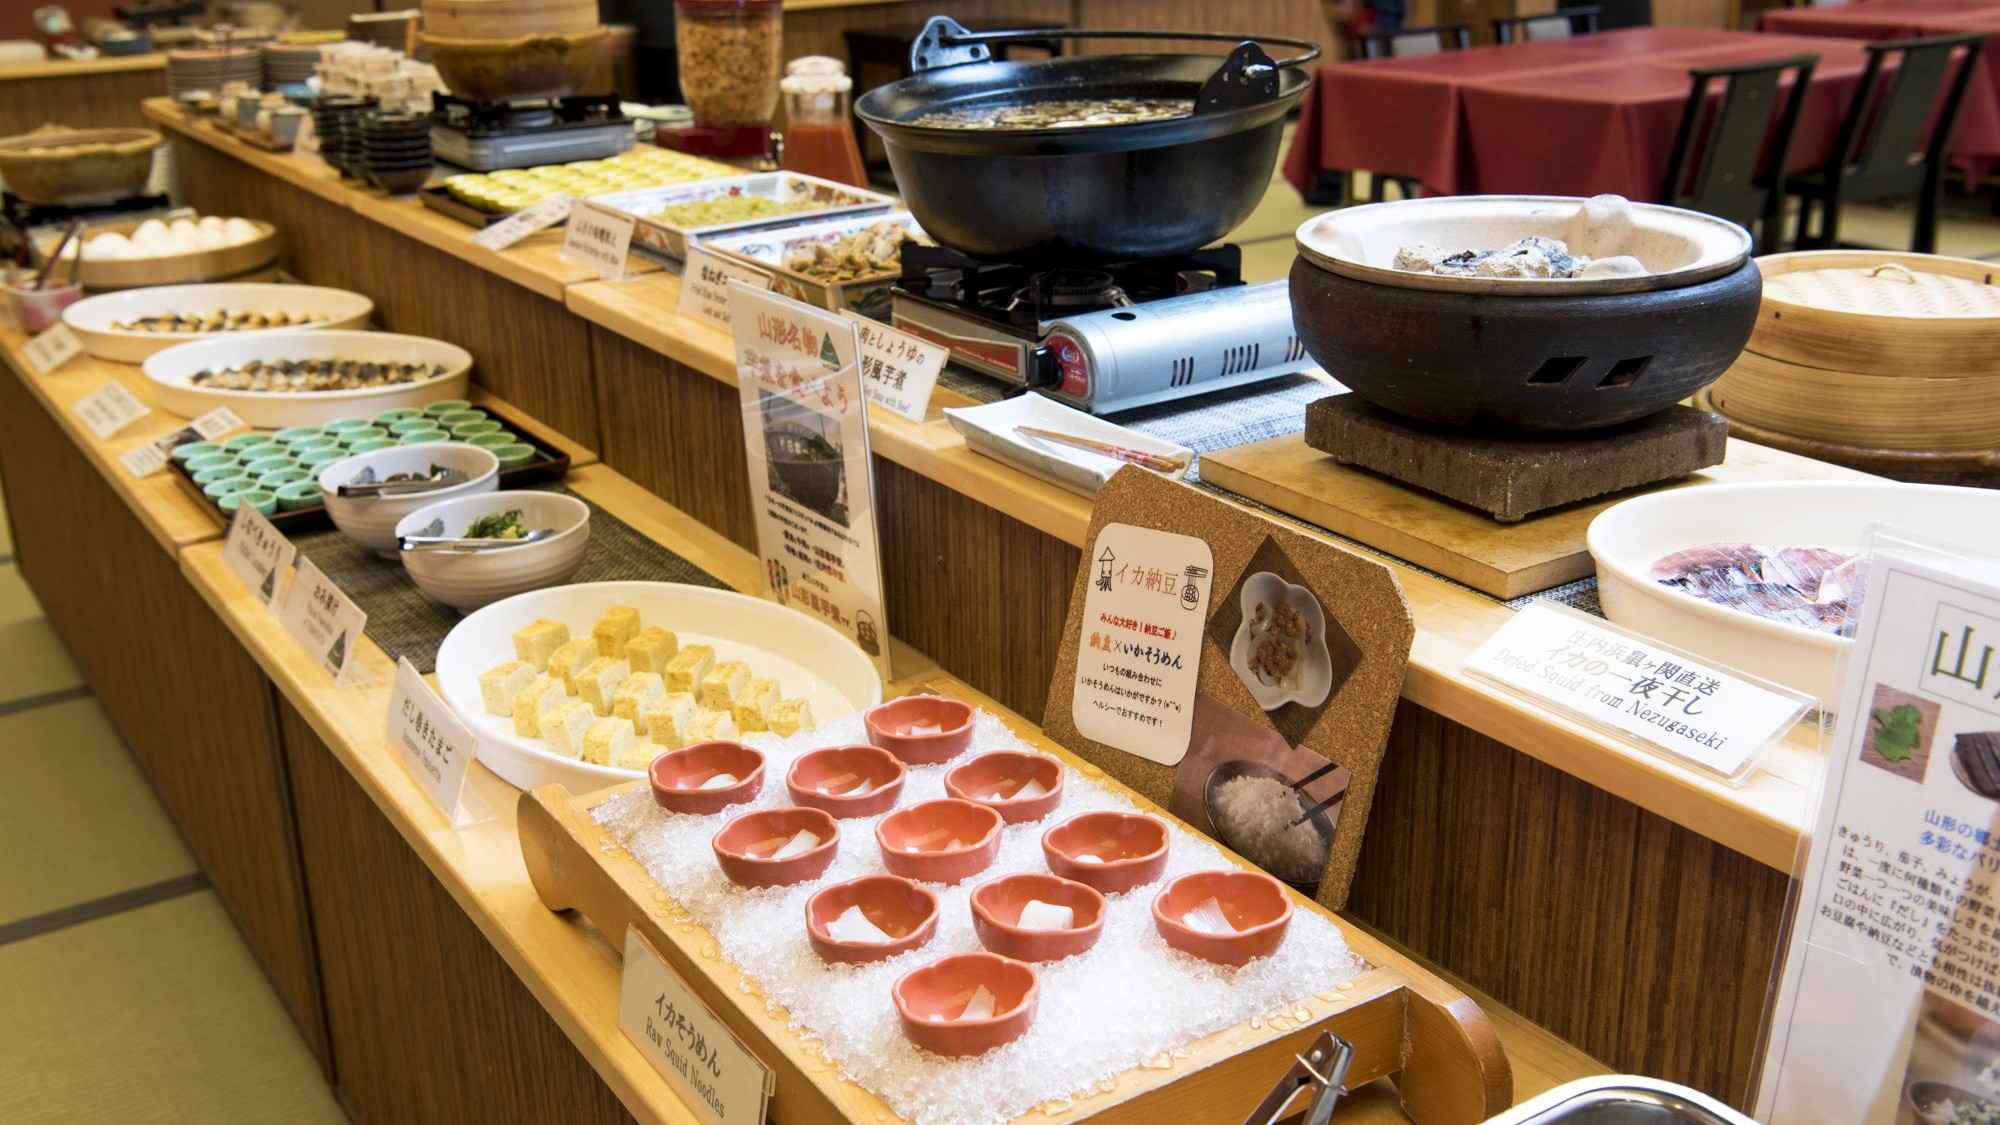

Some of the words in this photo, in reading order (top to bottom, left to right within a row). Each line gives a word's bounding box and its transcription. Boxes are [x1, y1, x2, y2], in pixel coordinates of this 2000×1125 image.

[757, 312, 818, 358] 山形名物
[1115, 563, 1179, 596] イカ納豆
[1102, 663, 1163, 687] いつもの組み合わせに
[1493, 647, 1540, 673] Dried
[1537, 664, 1585, 692] Squid
[1584, 683, 1624, 709] from
[1625, 699, 1729, 751] Nezugaseki
[1544, 645, 1704, 717] イカの一夜干し
[1931, 625, 2000, 699] 山
[401, 697, 453, 765] だし巻きたまご
[1842, 844, 2000, 921] は、一度に何種類もの野菜
[1819, 904, 2000, 997] お豆腐や納豆などとも相性は抜
[646, 1016, 663, 1047] Raw
[664, 1038, 689, 1079] Squid
[690, 1065, 725, 1119] Noodles
[655, 992, 721, 1079] イカそうめん
